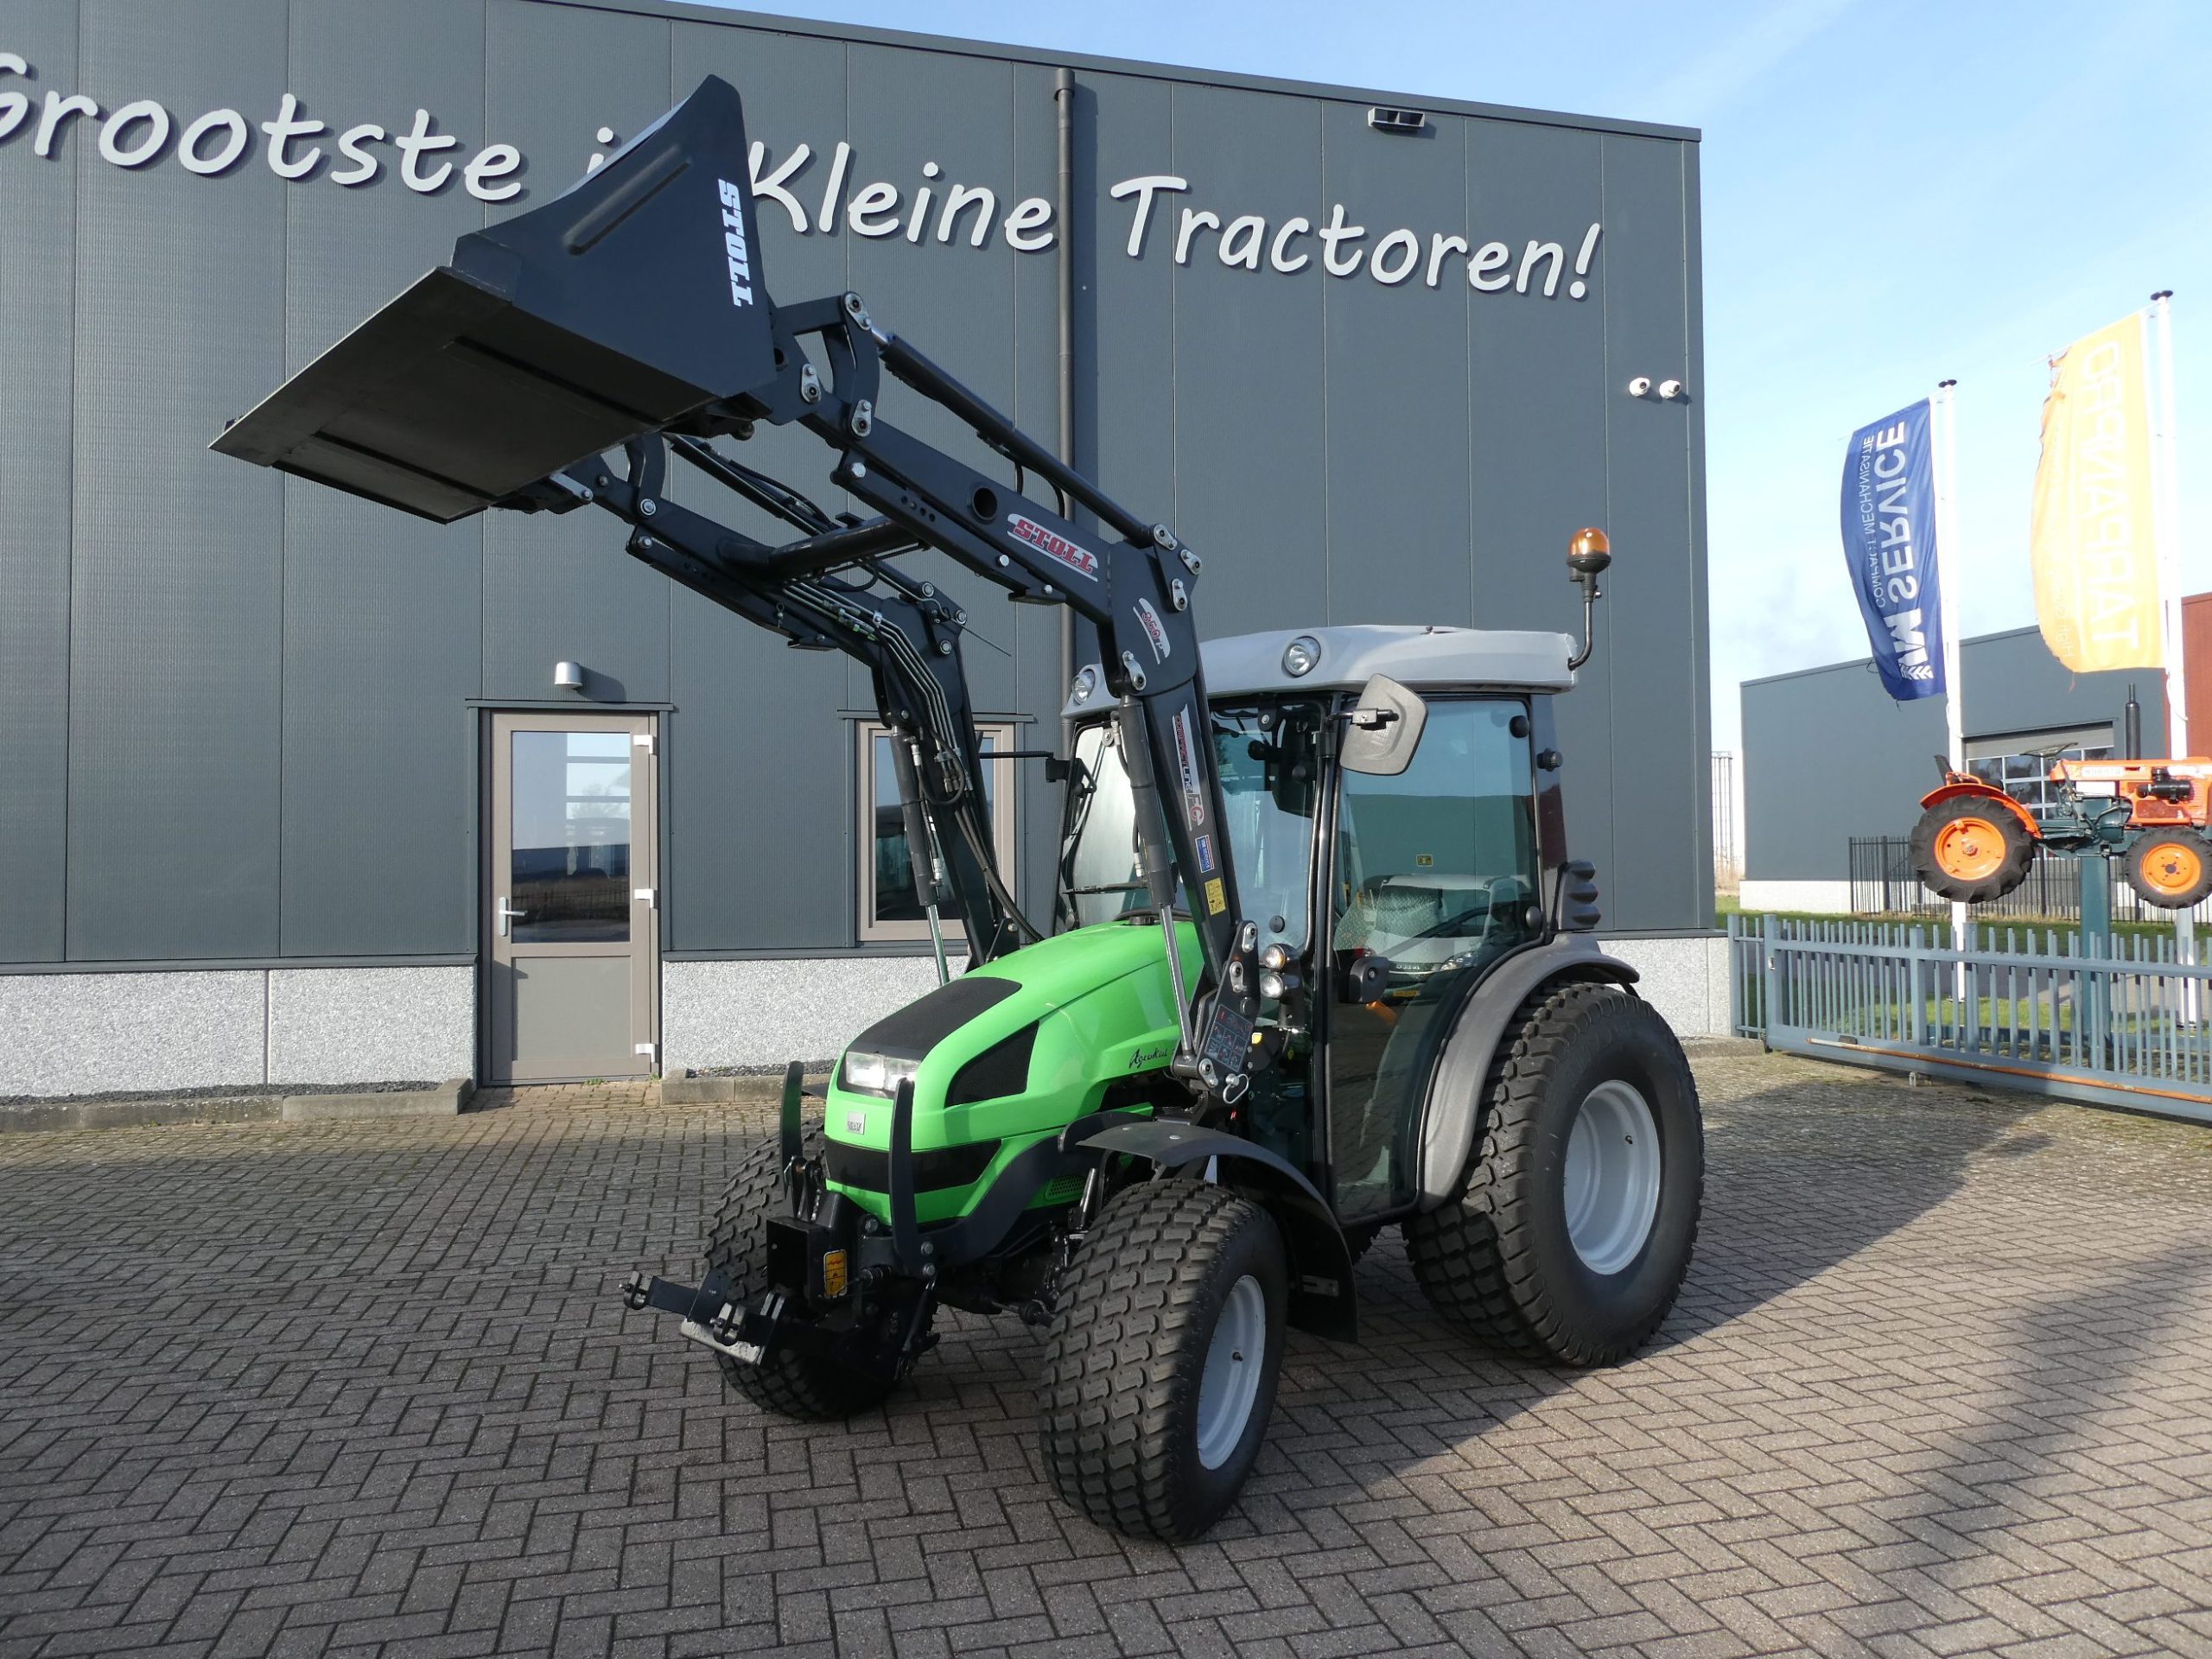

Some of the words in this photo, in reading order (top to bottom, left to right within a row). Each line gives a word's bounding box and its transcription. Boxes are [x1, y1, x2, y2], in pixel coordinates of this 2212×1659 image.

[717, 178, 753, 308] STOLL
[748, 141, 1055, 251] Kleine
[1110, 175, 1601, 300] Tractoren!
[1013, 518, 1094, 574] STOLL
